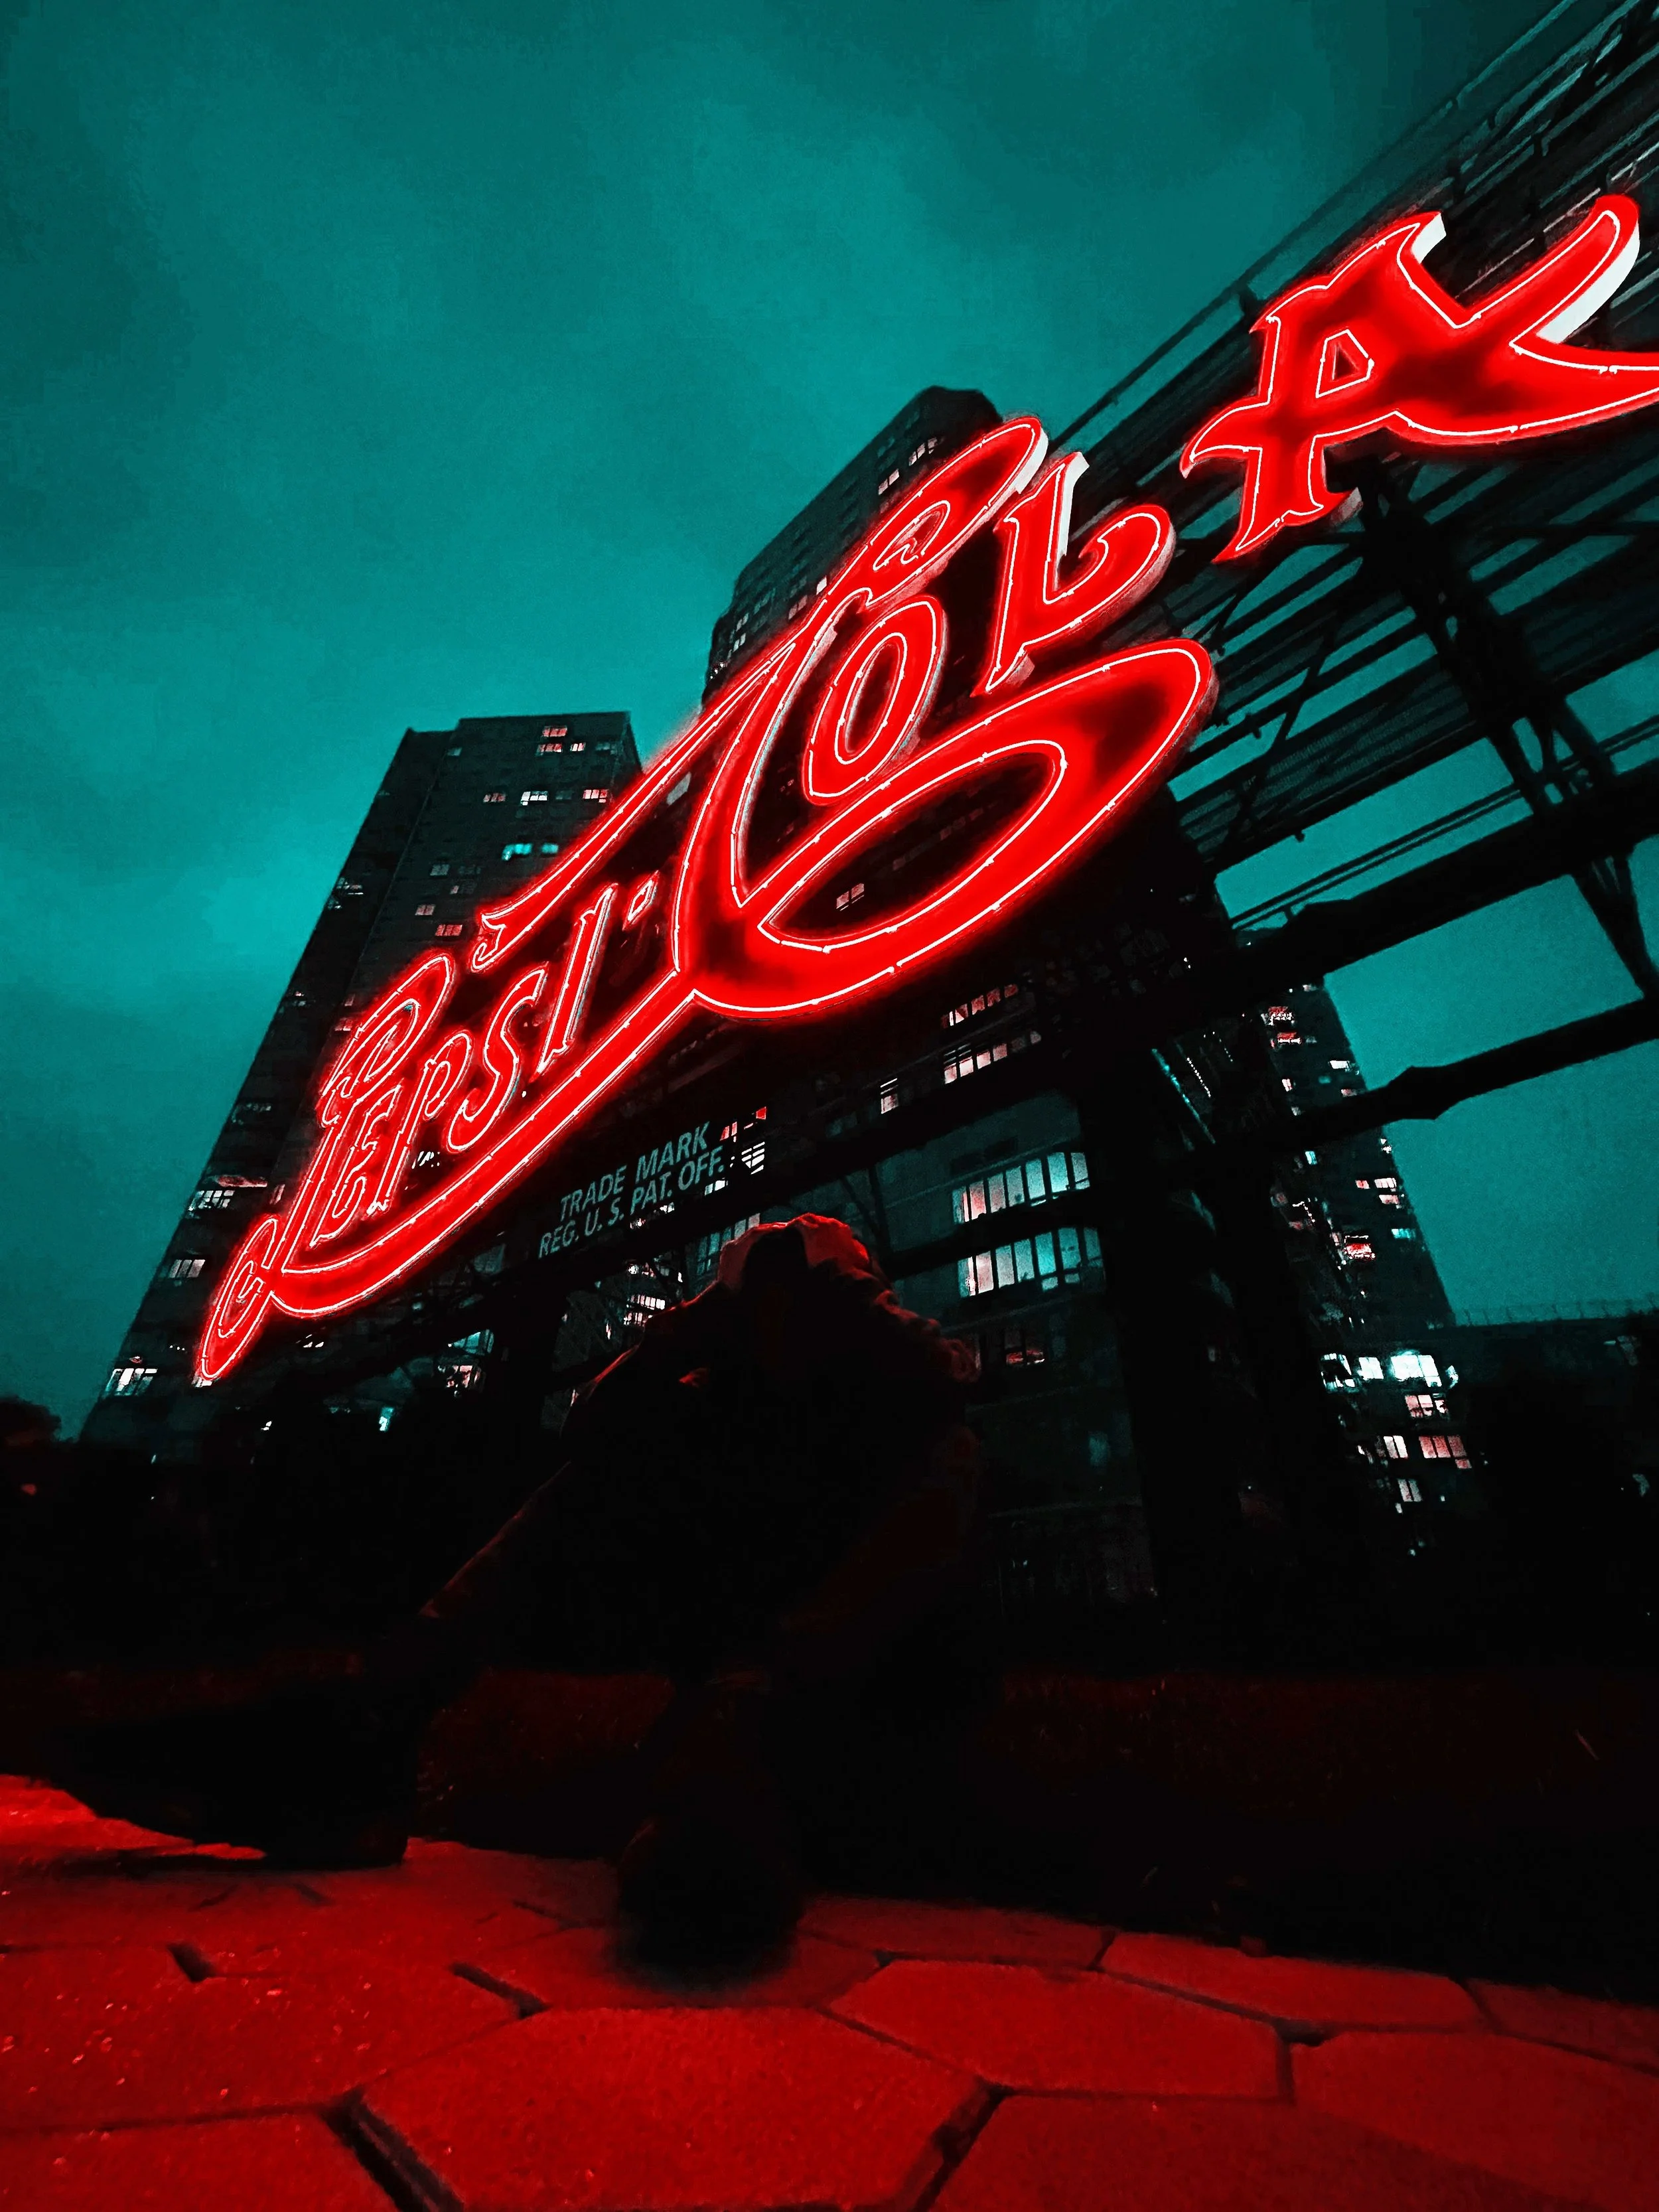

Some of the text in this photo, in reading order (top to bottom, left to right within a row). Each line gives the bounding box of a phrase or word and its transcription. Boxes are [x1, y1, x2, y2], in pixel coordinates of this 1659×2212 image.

[538, 1220, 579, 1260] REG.
[630, 1171, 673, 1216] PAT.
[678, 1145, 725, 1191] OFF.
[560, 1121, 710, 1222] TRADE MARK
